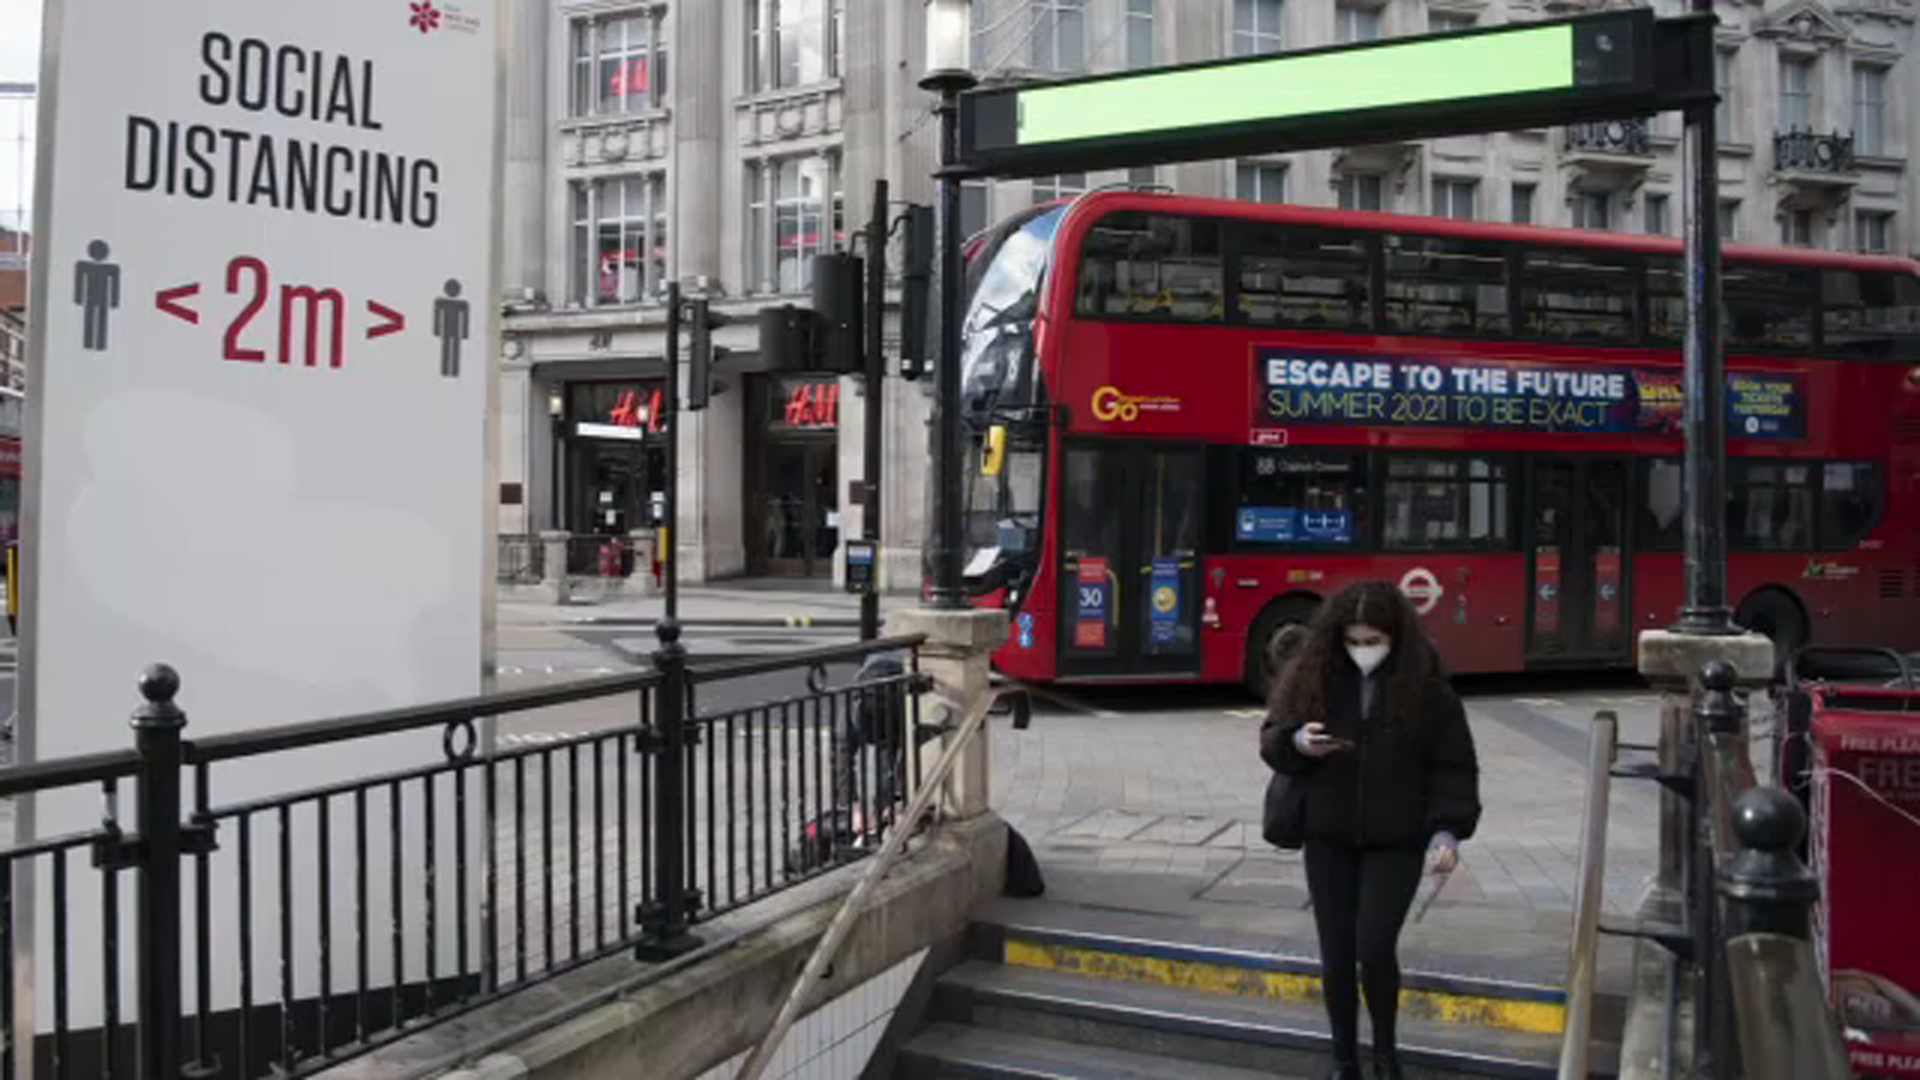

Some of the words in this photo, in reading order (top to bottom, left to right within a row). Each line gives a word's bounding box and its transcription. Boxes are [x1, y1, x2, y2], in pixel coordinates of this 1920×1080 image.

[199, 31, 383, 131] SOCIAL
[124, 115, 440, 229] DISTANCING
[1267, 359, 1391, 388] ESCAPE
[1400, 365, 1443, 392] TO
[1452, 367, 1508, 393] THE
[1516, 370, 1625, 398] FUTURE
[1268, 389, 1385, 417] SUMMER
[1392, 393, 1447, 421] 2021
[1453, 396, 1488, 422] TO
[1494, 398, 1524, 425] BE
[1530, 400, 1609, 427] EXACT
[1079, 587, 1103, 607] 30
[1840, 734, 1880, 751] FREE
